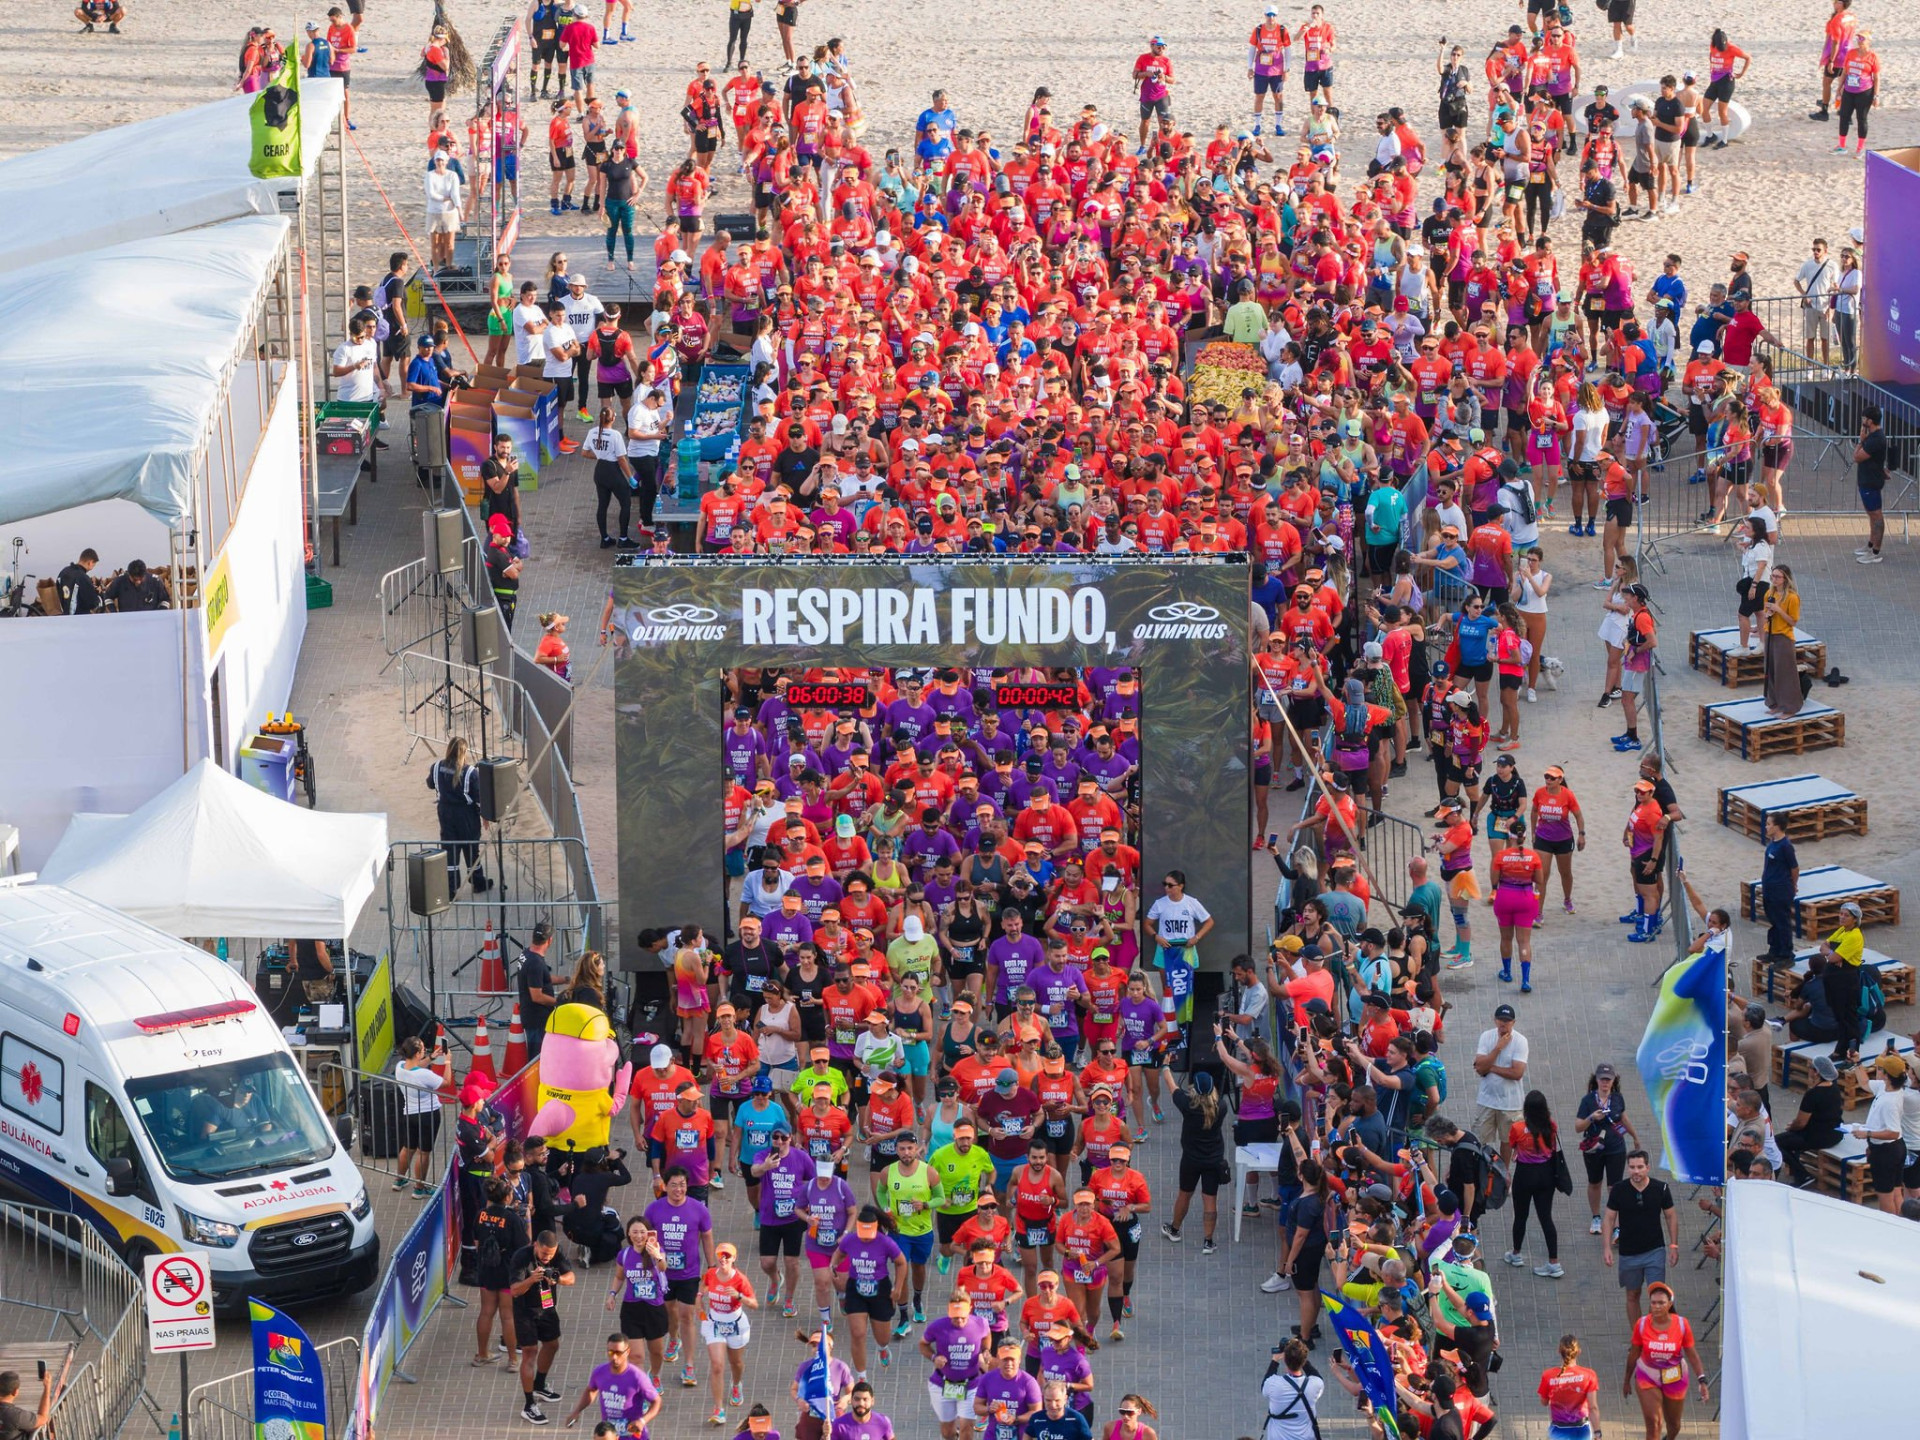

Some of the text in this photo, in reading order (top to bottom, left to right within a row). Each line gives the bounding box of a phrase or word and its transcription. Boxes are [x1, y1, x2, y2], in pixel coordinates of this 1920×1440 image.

[568, 313, 590, 325] STAFF
[742, 587, 1116, 655] RESPIRA FUNDO,
[632, 624, 726, 642] OLYMPIKUS
[1132, 622, 1228, 640] OLYMPIKUS
[788, 686, 865, 704] 06:00:38
[998, 687, 1075, 705] 00:00:42
[1165, 920, 1188, 933] STAFF
[1172, 968, 1188, 996] BPC
[1051, 1015, 1066, 1024] 1514
[201, 1048, 222, 1056] Easy
[1042, 1092, 1067, 1100] BOTA PRA
[1005, 1123, 1021, 1132] 1268
[1050, 1125, 1064, 1133] 1381
[680, 1133, 695, 1143] 1591
[785, 1174, 795, 1182] PRA
[773, 1181, 793, 1189] CORRER
[1103, 1190, 1127, 1199] BOTA PRA
[778, 1204, 794, 1212] 1522
[663, 1224, 676, 1232] BOTA
[664, 1232, 684, 1240] CORRER
[820, 1234, 835, 1242] 1629
[1030, 1231, 1046, 1242] 1027
[852, 1259, 876, 1268] BOTA PRA
[627, 1270, 642, 1278] BOTA
[860, 1284, 875, 1292] 1501
[176, 1328, 210, 1336] PRAIAS
[963, 1344, 975, 1352] PRA
[1649, 1342, 1676, 1351] BOTA PRA
[258, 1366, 314, 1384] PETER CHEMICAL
[264, 1398, 278, 1406] MAIS
[303, 1402, 318, 1410] LEVA
